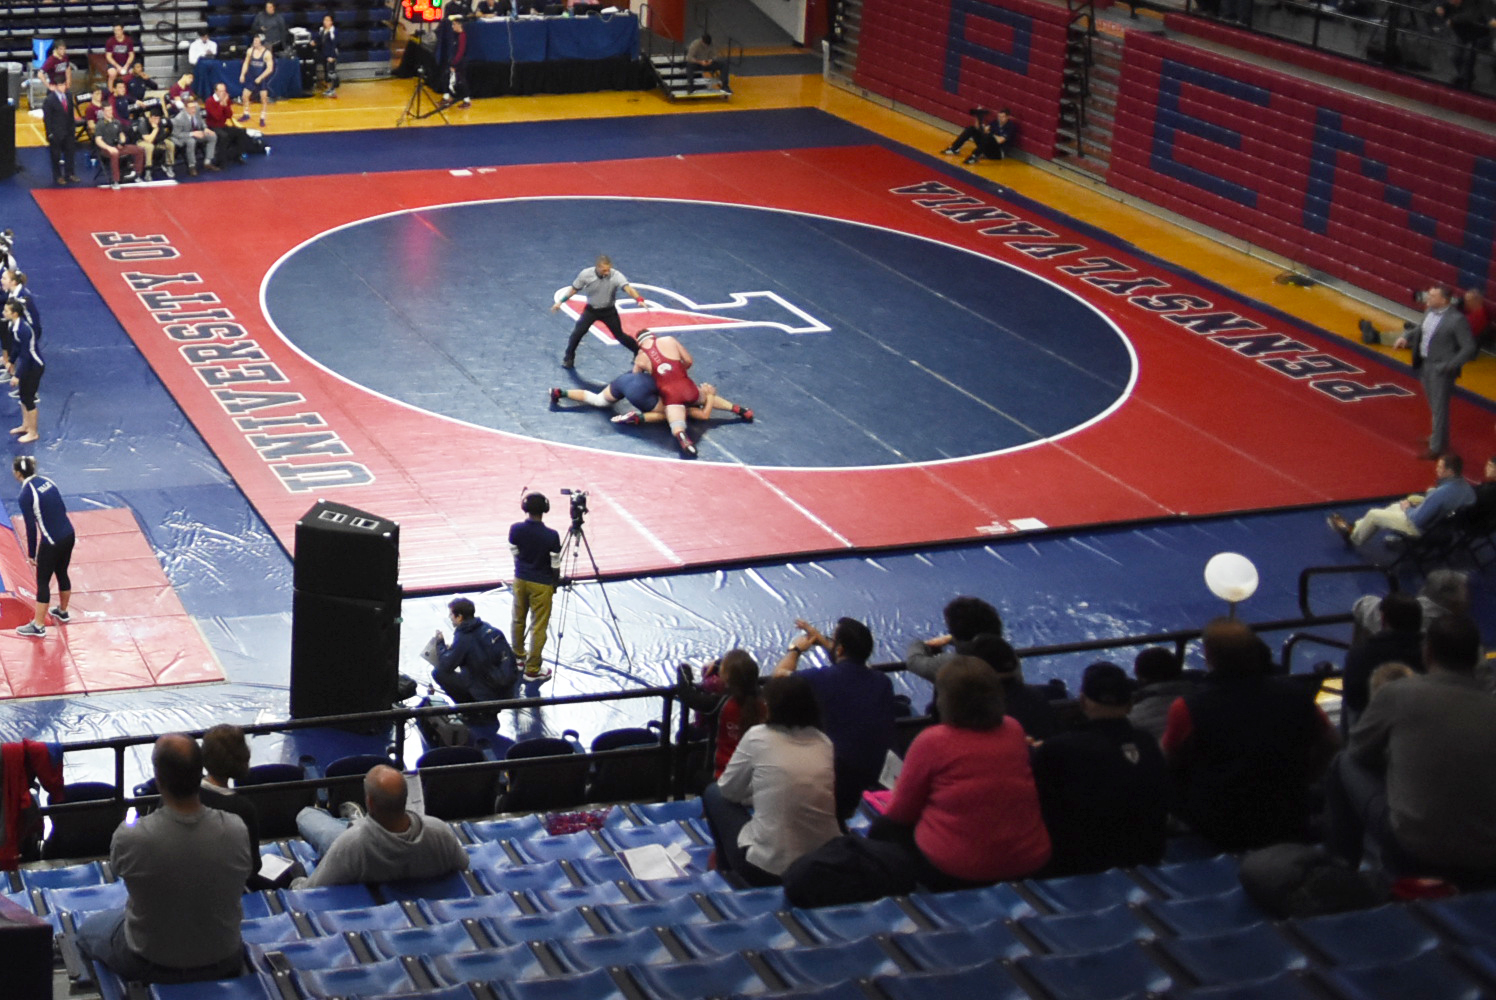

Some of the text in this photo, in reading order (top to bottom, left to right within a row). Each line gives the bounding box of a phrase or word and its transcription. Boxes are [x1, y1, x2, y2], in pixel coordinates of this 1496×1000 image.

[91, 231, 376, 494] UNIVERSITY OF
[889, 179, 1416, 403] PENNSYLVANIA
